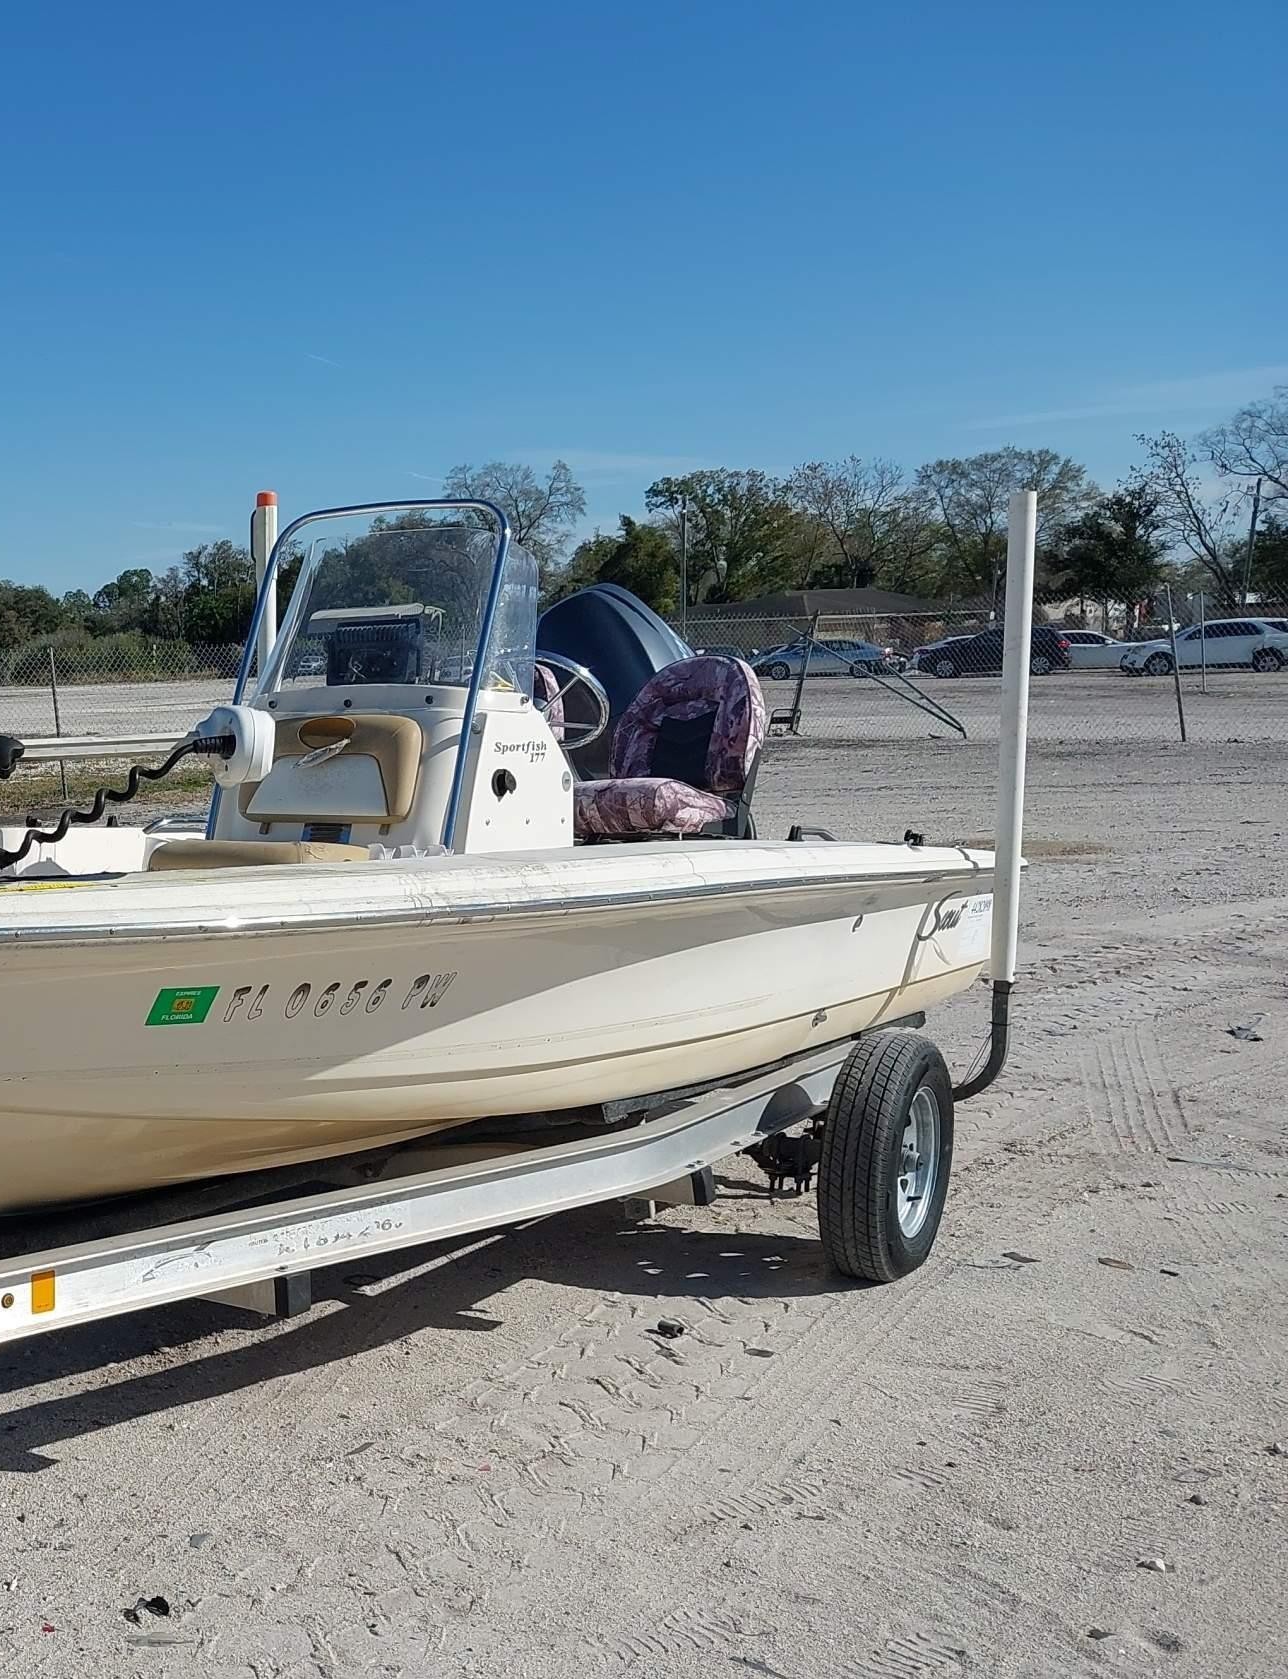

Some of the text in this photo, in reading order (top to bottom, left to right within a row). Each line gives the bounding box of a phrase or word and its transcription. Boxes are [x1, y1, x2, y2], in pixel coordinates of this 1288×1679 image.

[494, 741, 547, 755] Sportfish
[530, 752, 546, 763] 177
[223, 971, 458, 1022] FL 0656 PW
[160, 1013, 193, 1021] FLORIDA
